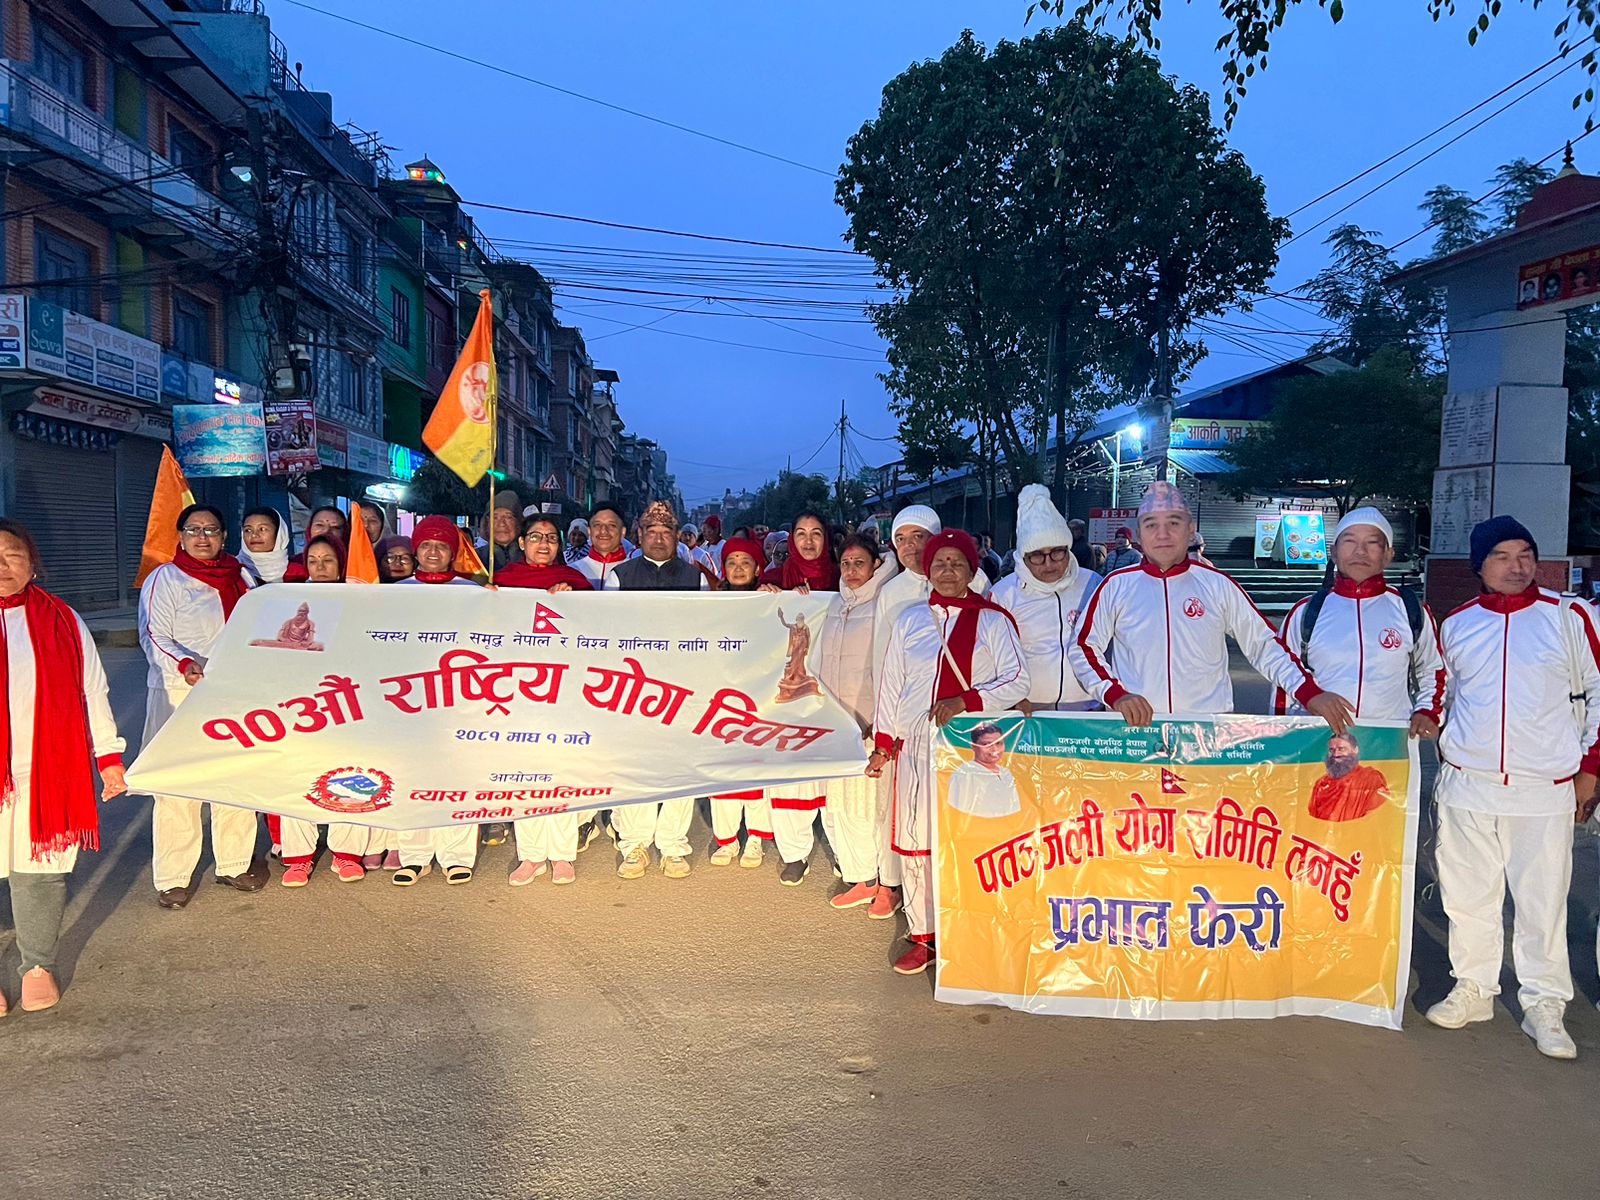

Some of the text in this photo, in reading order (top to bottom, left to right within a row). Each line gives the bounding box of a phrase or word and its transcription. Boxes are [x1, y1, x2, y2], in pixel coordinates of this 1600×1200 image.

[31, 329, 62, 355] Sewa
[1101, 509, 1137, 518] HELM
[513, 631, 550, 648] नेपाल
[559, 635, 569, 648] र
[576, 634, 609, 651] विश्व
[618, 636, 669, 652] शान्तिका
[677, 637, 709, 652] लागि
[379, 649, 569, 715] राष्ट्रिय
[582, 657, 694, 727] योग
[692, 688, 835, 752] दिवस
[455, 729, 501, 742] २०८१
[506, 730, 542, 744] माघ
[563, 731, 593, 746] गते
[1126, 738, 1147, 748] नेपाल
[1239, 741, 1266, 751] समिति
[1080, 746, 1095, 755] योग
[1098, 747, 1123, 756] समिति
[1226, 750, 1253, 759] समिति
[489, 771, 553, 782] आयोजक
[409, 785, 614, 802] व्यास नगरपालिका
[1114, 792, 1176, 853] योग
[1186, 797, 1282, 870] समिति
[1048, 885, 1285, 953] प्रभात फेरी
